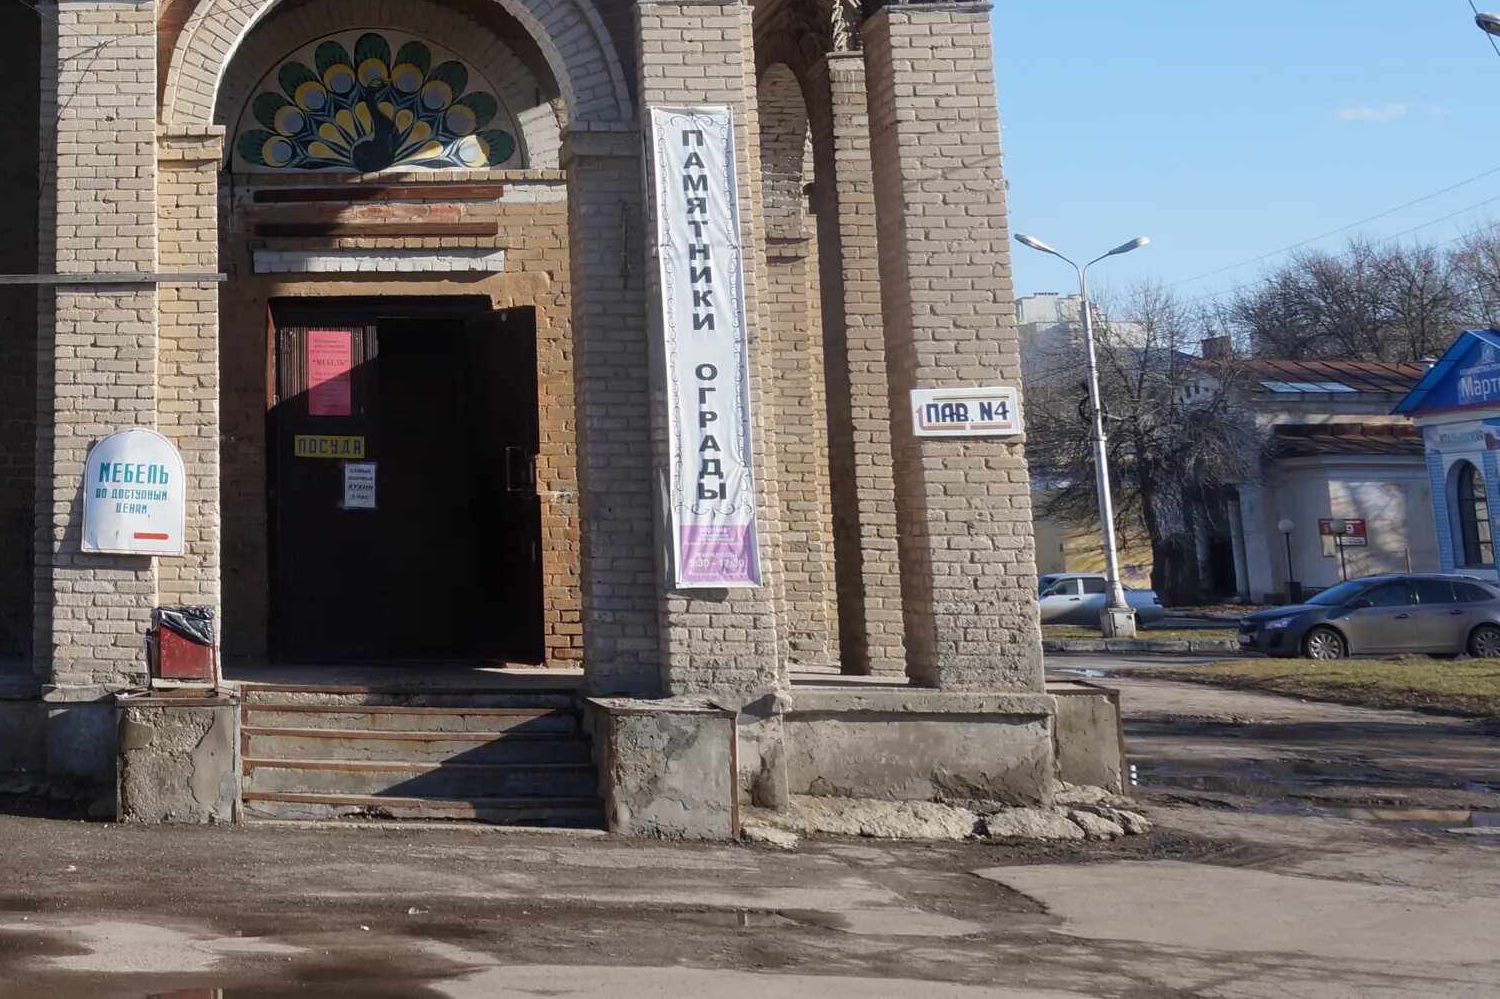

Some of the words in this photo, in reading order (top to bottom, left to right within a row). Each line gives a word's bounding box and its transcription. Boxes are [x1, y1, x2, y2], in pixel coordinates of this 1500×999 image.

[681, 128, 716, 331] ПАМЯТНИКИ
[1459, 375, 1500, 402] Март
[925, 402, 975, 423] ПАВ.
[978, 400, 1010, 422] N4
[694, 362, 728, 501] ОГРАДЫ
[298, 438, 362, 455] ПОСУДА
[98, 461, 170, 485] МЕБЕЛЬ
[95, 487, 108, 499] ПО
[111, 488, 168, 502] ДОСТУПНЫМ
[115, 502, 148, 515] ЦЕНАМ
[689, 558, 710, 568] 9:30
[719, 558, 746, 568] 17:30
